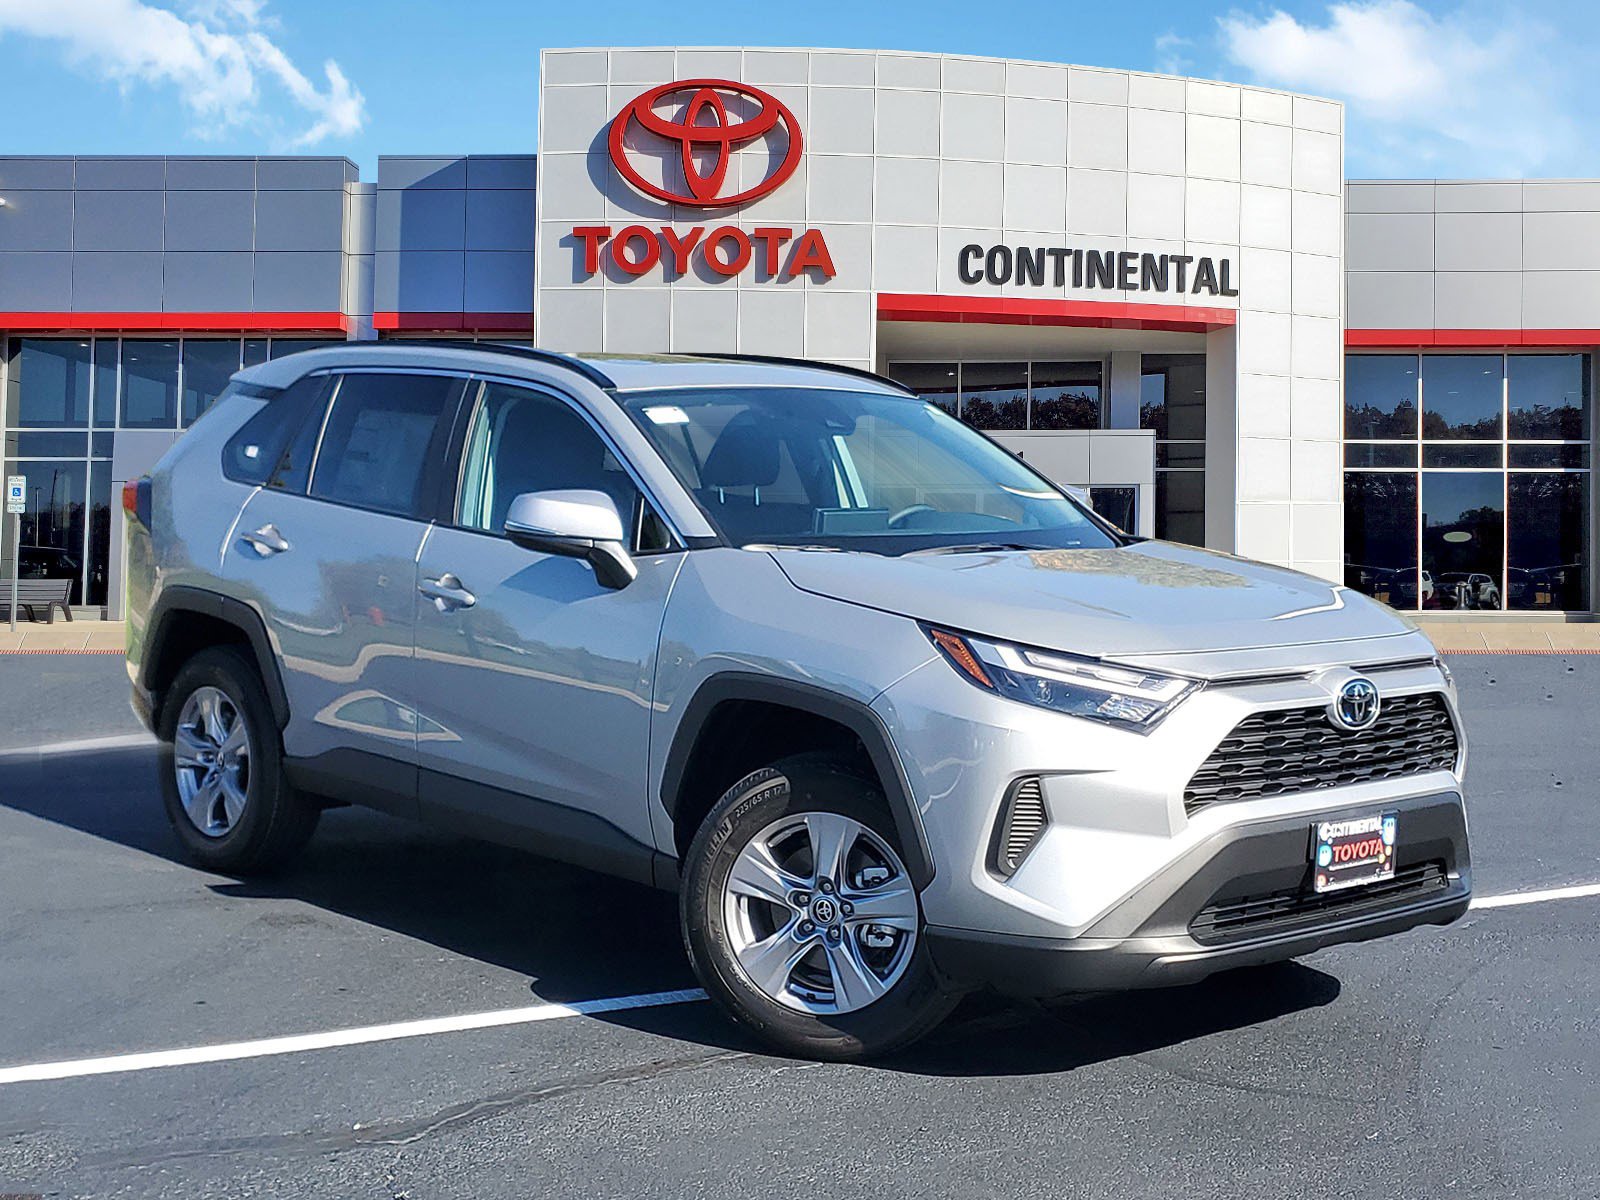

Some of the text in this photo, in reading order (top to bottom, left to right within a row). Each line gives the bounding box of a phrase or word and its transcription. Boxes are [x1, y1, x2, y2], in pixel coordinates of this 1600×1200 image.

[572, 225, 837, 277] TOYOTA
[958, 244, 1239, 297] CONTINENTAL
[735, 793, 763, 818] 225/65
[1332, 838, 1384, 863] TOYOTA
